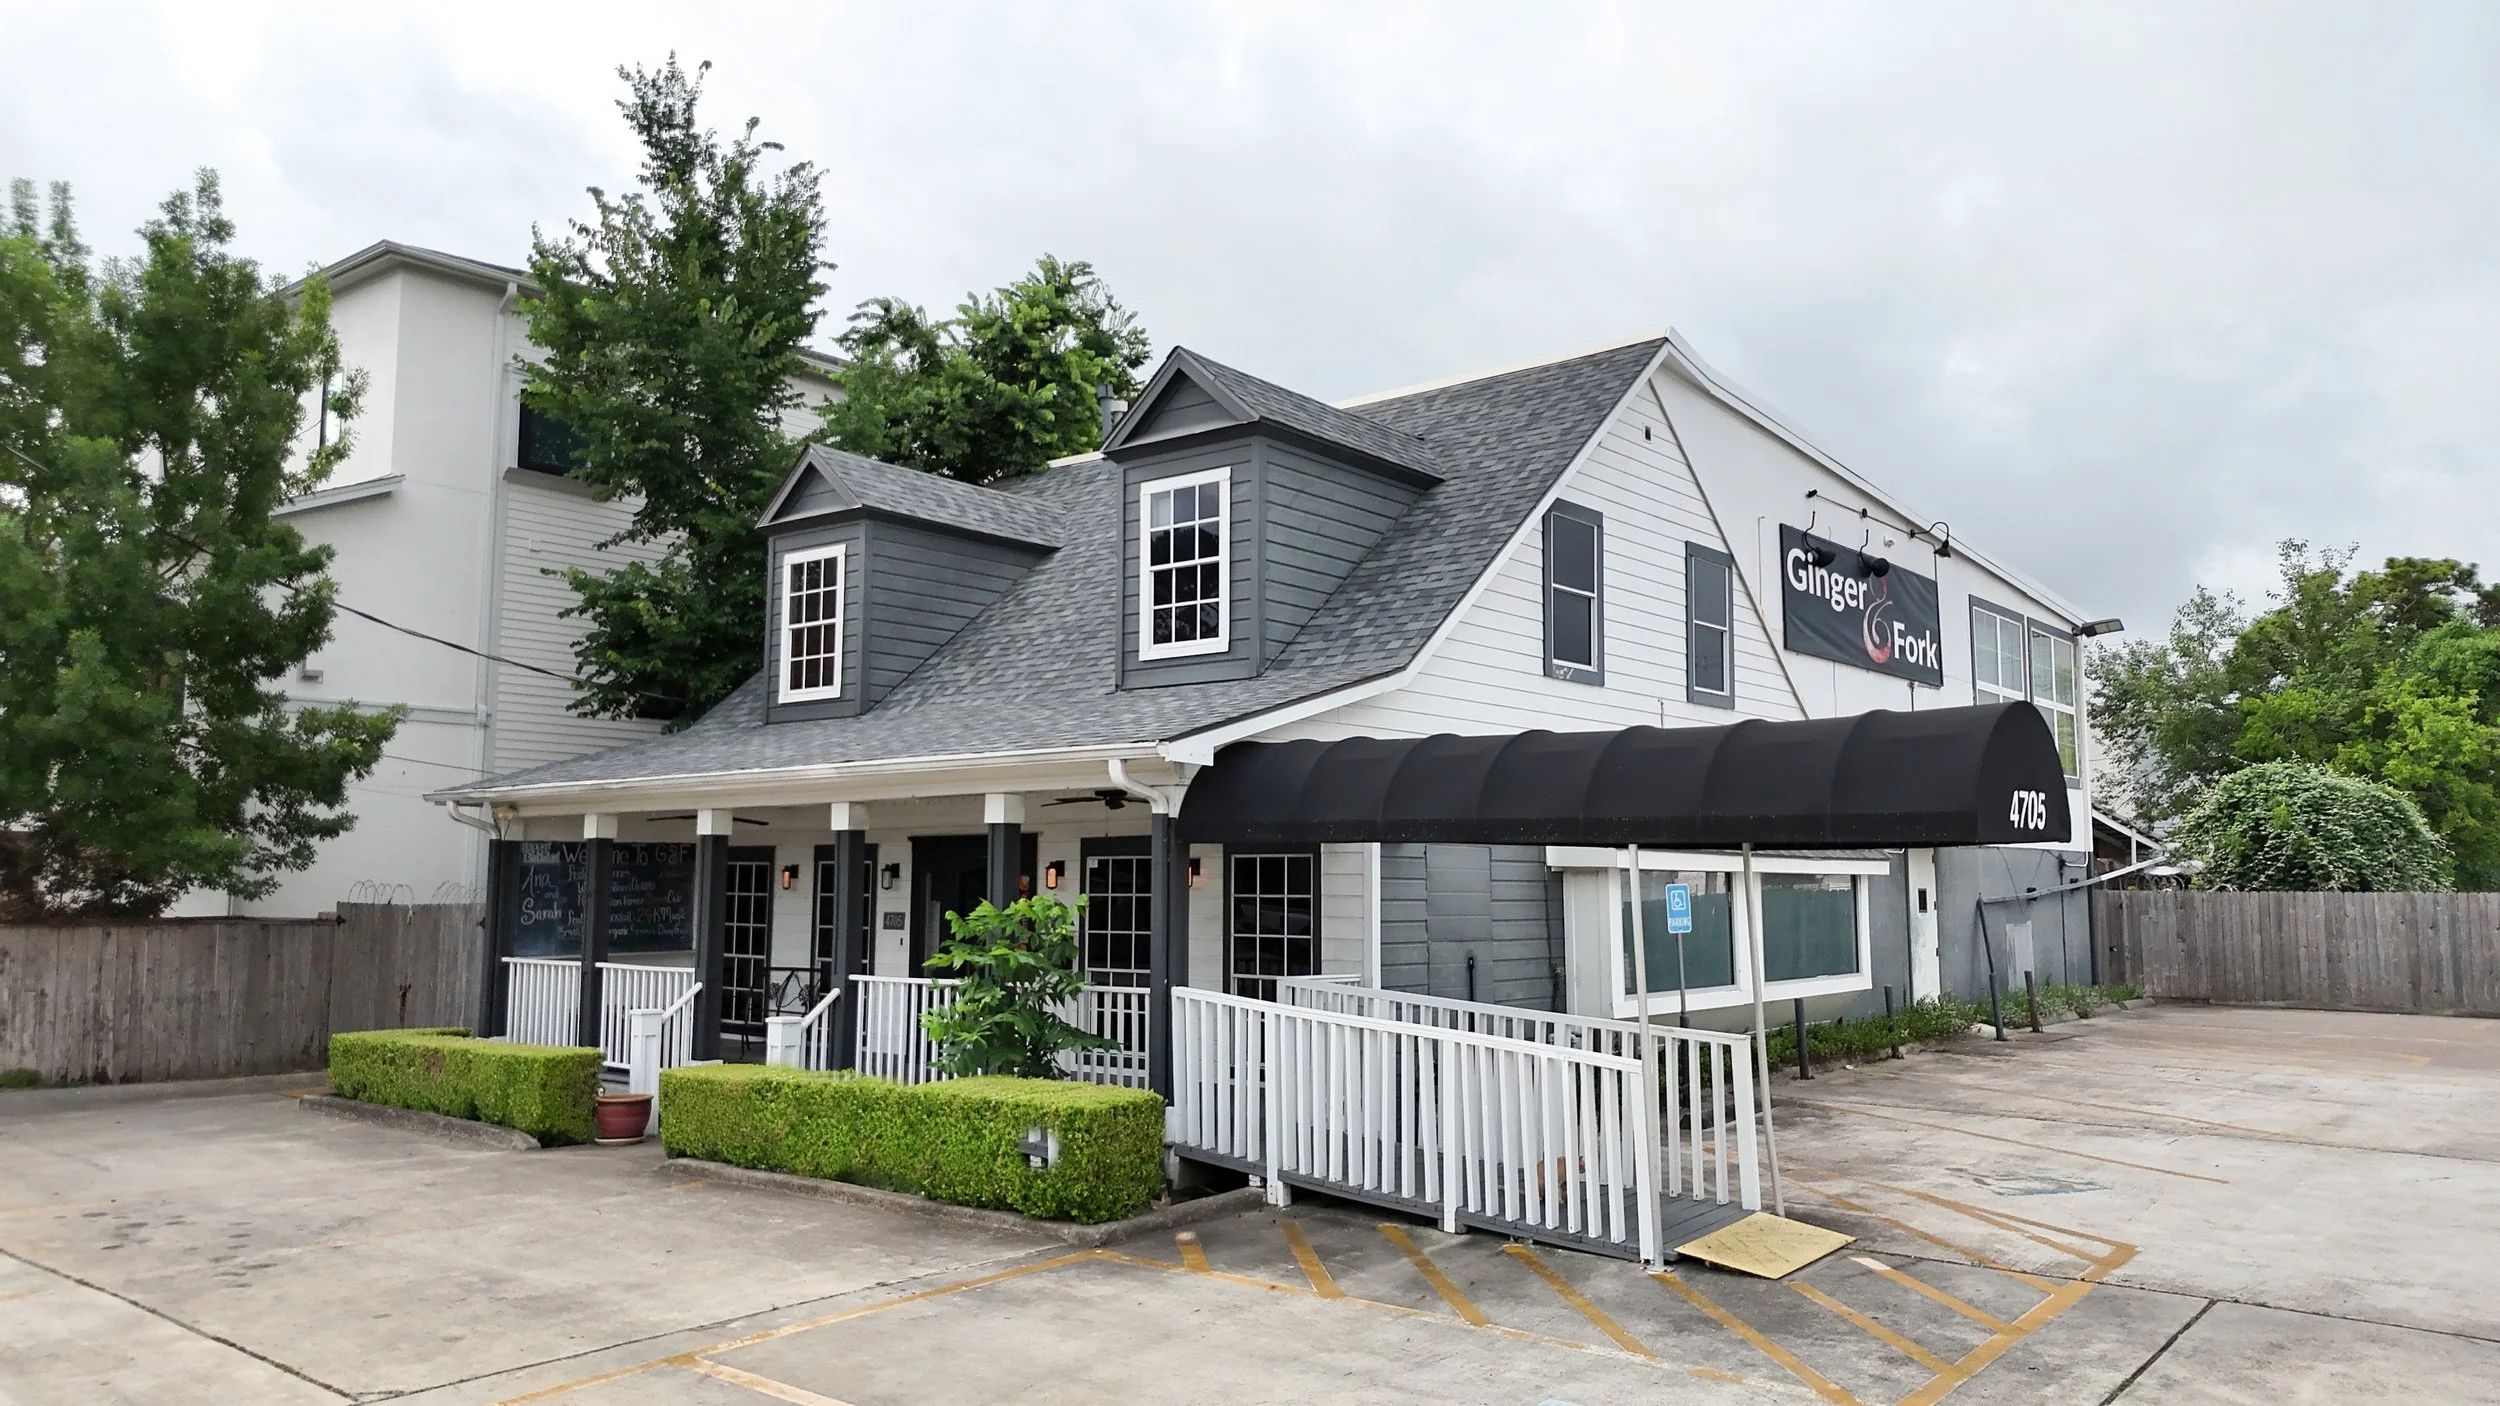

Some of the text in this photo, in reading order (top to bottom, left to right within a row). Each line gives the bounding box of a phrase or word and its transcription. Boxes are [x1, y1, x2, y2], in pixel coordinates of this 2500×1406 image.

[1786, 548, 1867, 612] Ginger
[1893, 620, 1939, 670] Fork
[2010, 790, 2046, 830] 4705
[521, 897, 562, 925] Sarah
